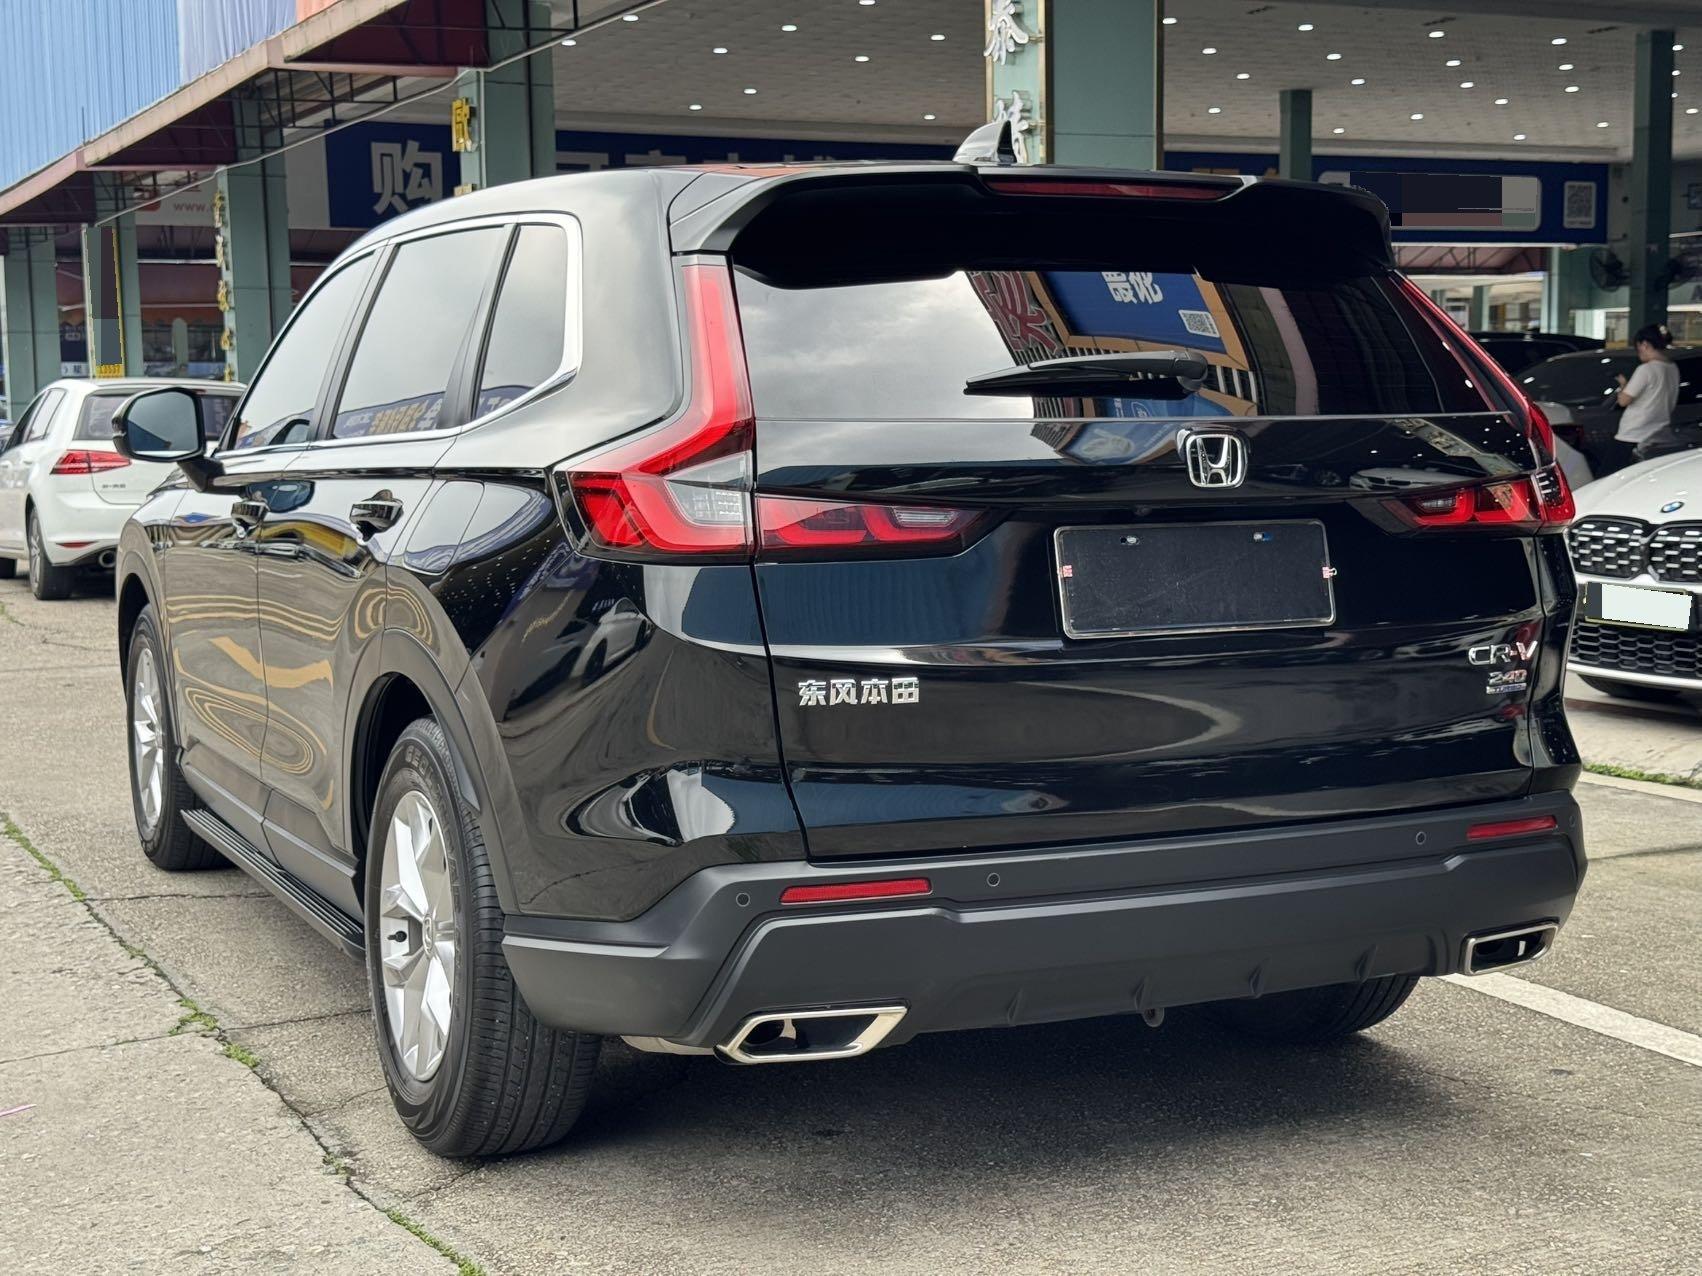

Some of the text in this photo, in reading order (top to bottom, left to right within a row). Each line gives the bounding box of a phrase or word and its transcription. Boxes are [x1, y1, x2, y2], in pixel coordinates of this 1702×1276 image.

[369, 139, 443, 215] 购
[1469, 641, 1538, 665] CR-V
[1488, 669, 1527, 685] 240
[798, 677, 920, 706] 东风本田
